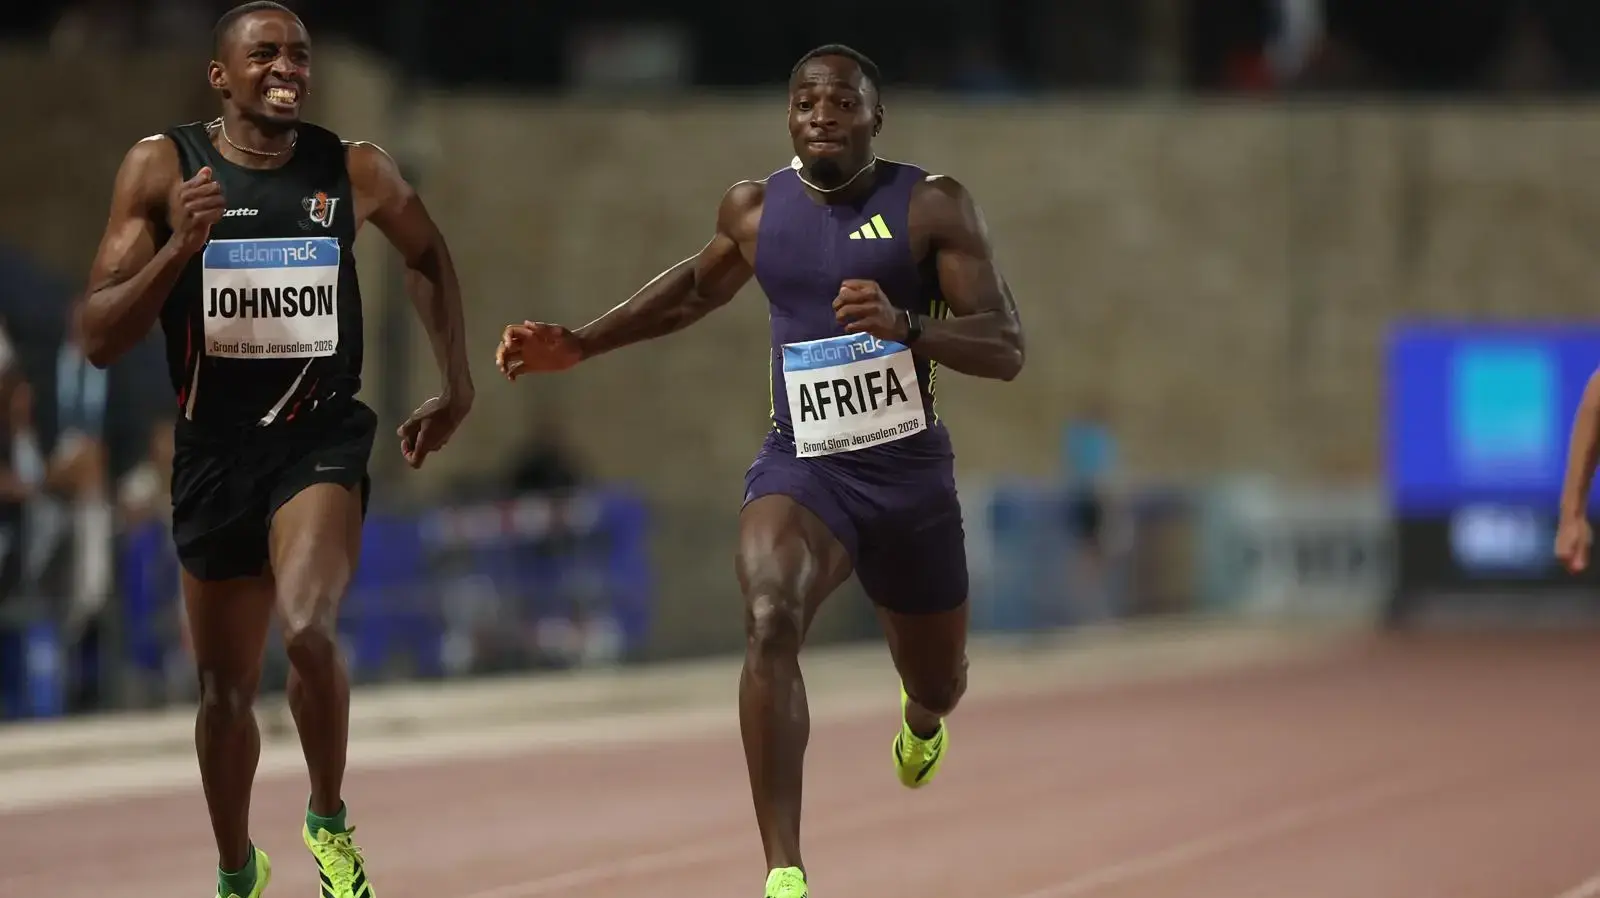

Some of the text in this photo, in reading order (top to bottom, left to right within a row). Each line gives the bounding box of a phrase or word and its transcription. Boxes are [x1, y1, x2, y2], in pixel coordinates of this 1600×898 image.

[308, 198, 340, 228] UJ
[208, 285, 333, 318] JOHNSON
[213, 340, 333, 354] Grand Slam Jerusalem 2026
[799, 367, 909, 423] AFRIFA
[803, 418, 919, 453] Grand Slam Jerusalem 2026
